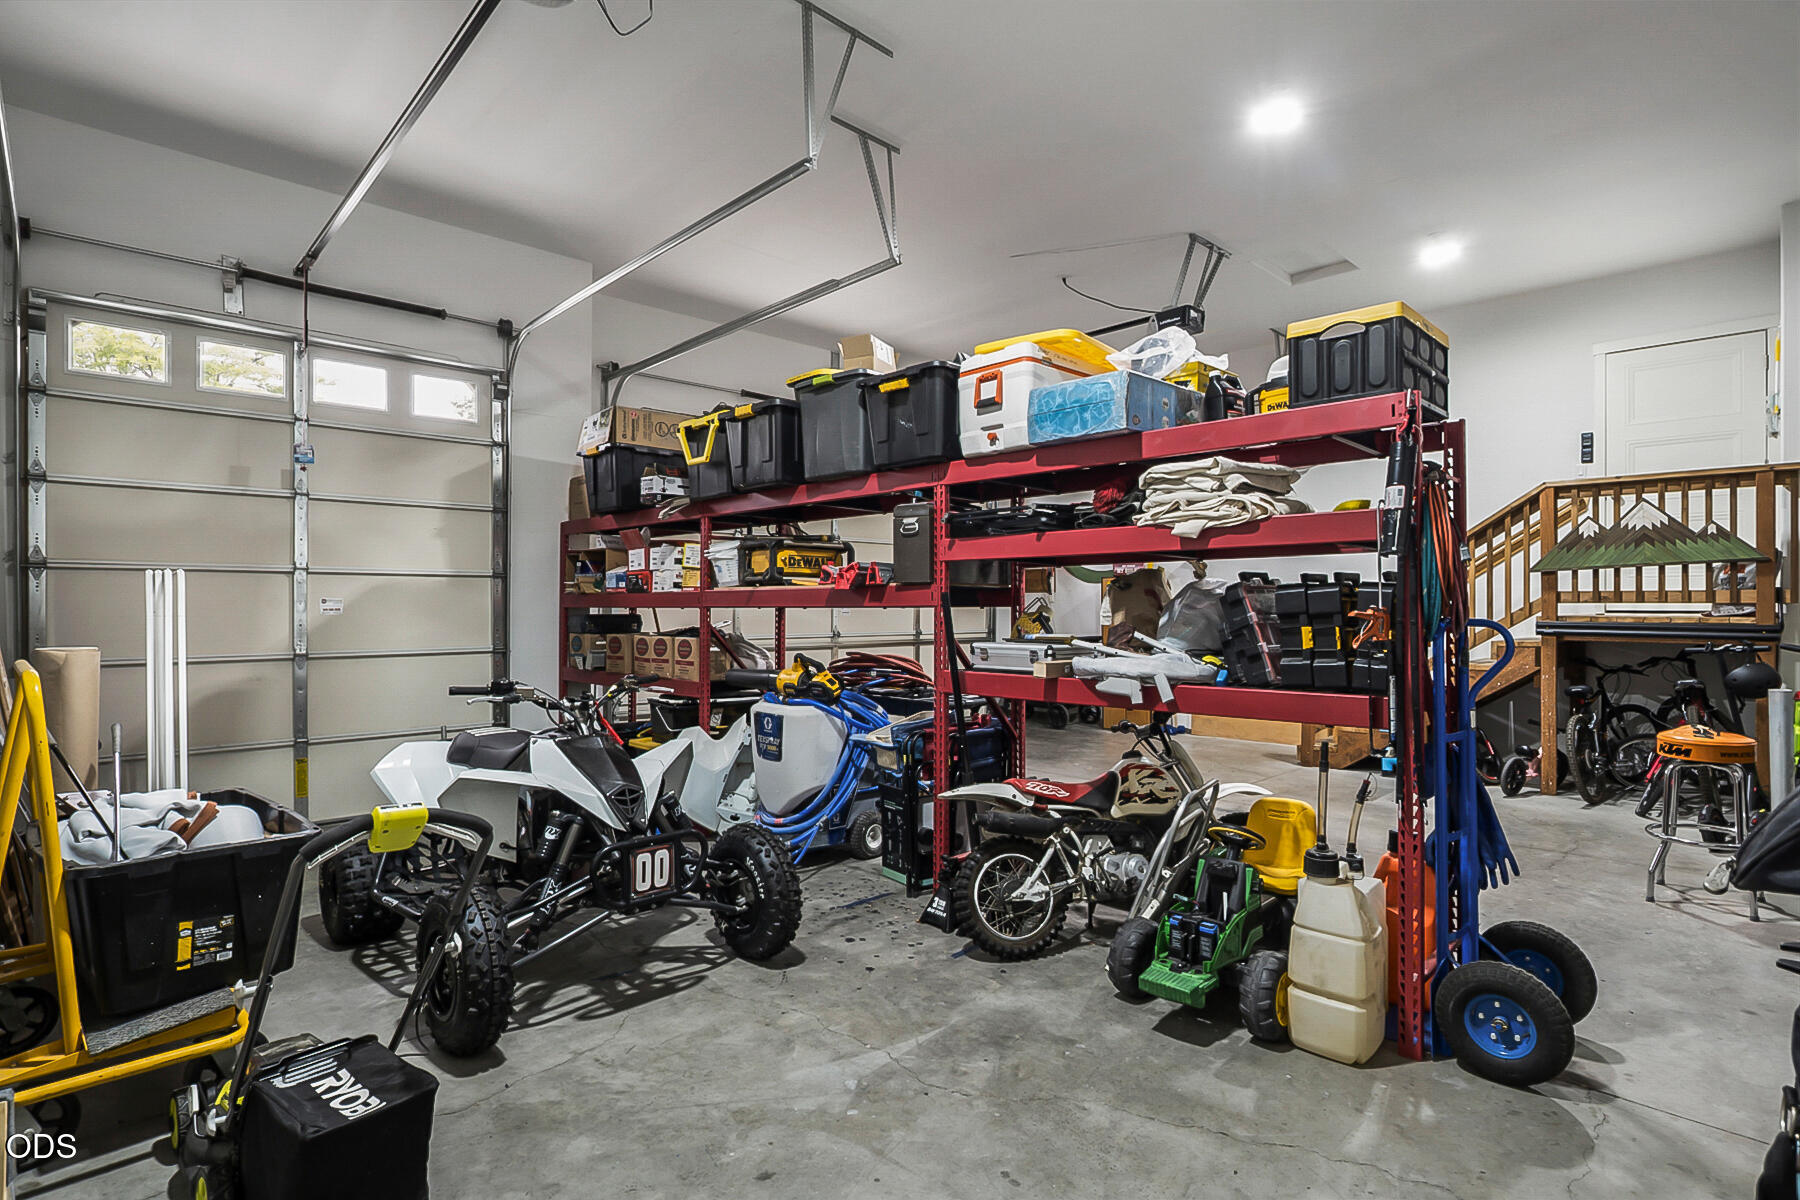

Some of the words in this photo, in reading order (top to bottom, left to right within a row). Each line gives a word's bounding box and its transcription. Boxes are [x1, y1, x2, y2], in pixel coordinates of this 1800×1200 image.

[1267, 401, 1289, 412] DEWA
[1659, 742, 1693, 758] KTM
[635, 849, 670, 892] 00
[932, 896, 940, 908] 3
[310, 1068, 387, 1121] RYOBI
